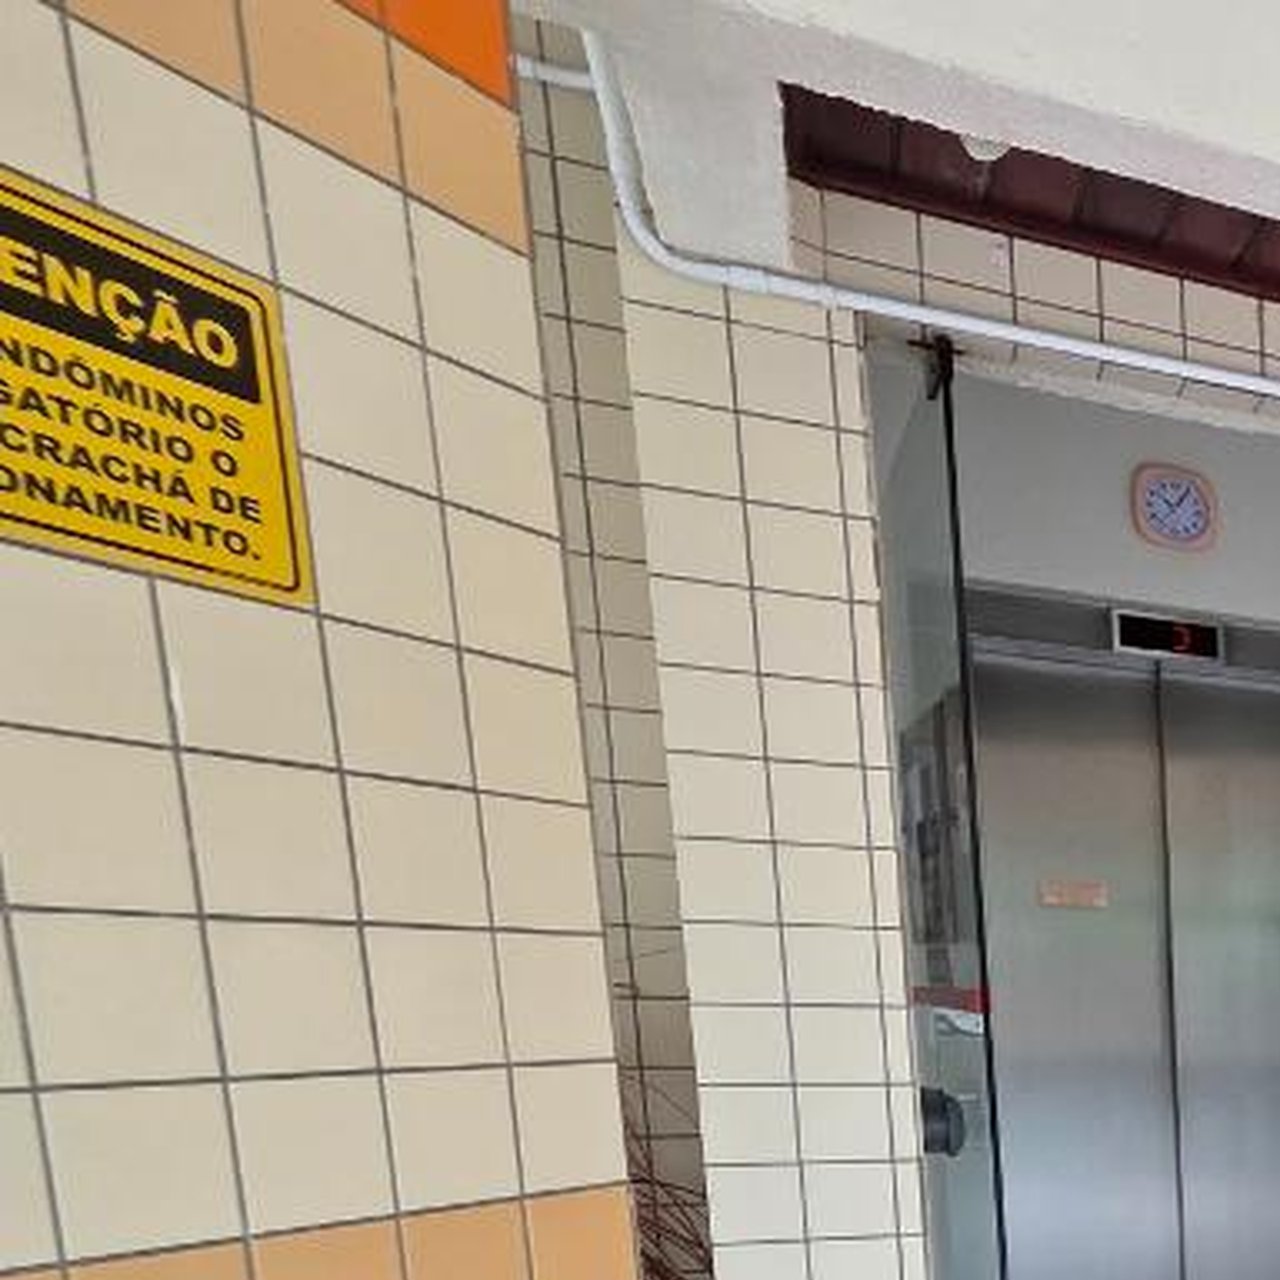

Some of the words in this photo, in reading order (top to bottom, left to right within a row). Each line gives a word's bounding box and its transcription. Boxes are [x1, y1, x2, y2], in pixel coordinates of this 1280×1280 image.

[0, 235, 239, 369] ENÇÃO
[0, 422, 196, 505] CRACHÁ
[210, 485, 263, 525] DE
[210, 448, 239, 477] O
